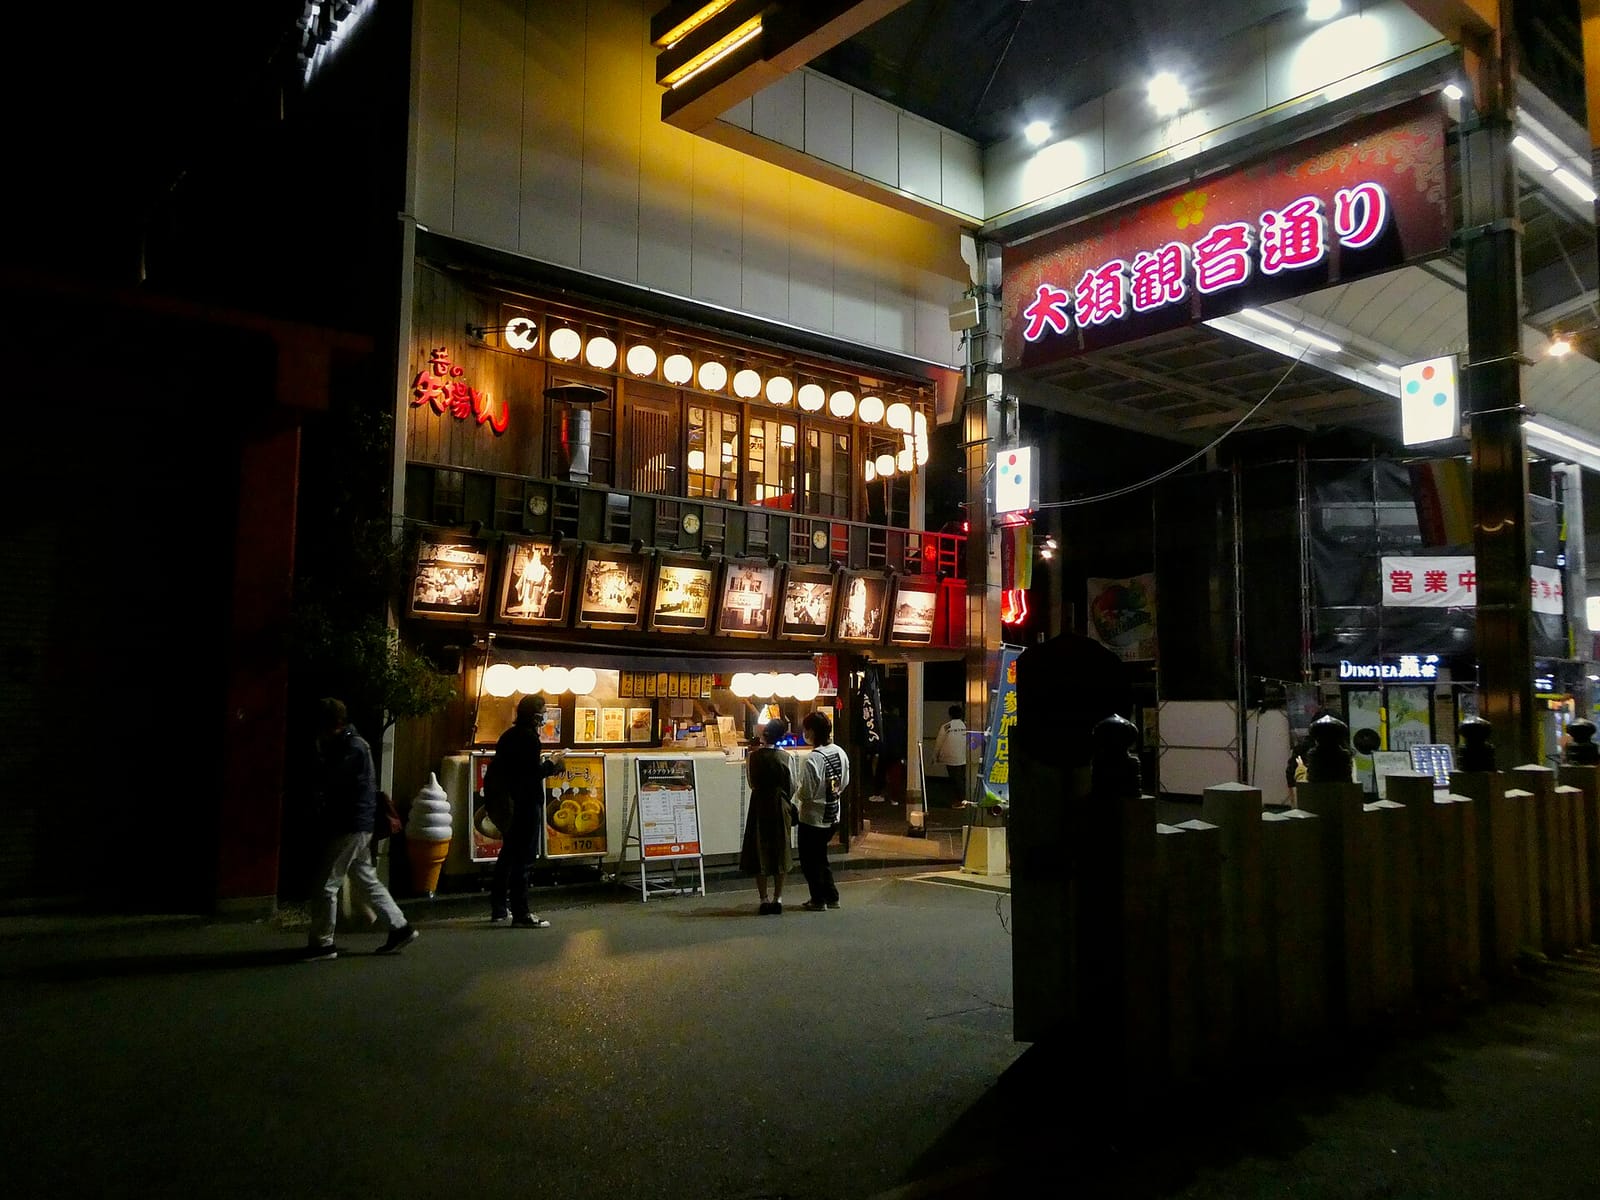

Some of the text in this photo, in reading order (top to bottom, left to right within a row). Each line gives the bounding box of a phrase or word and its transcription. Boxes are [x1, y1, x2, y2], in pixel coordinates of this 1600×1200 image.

[1022, 182, 1388, 341] 大須観音通り
[1390, 570, 1477, 593] 営業中
